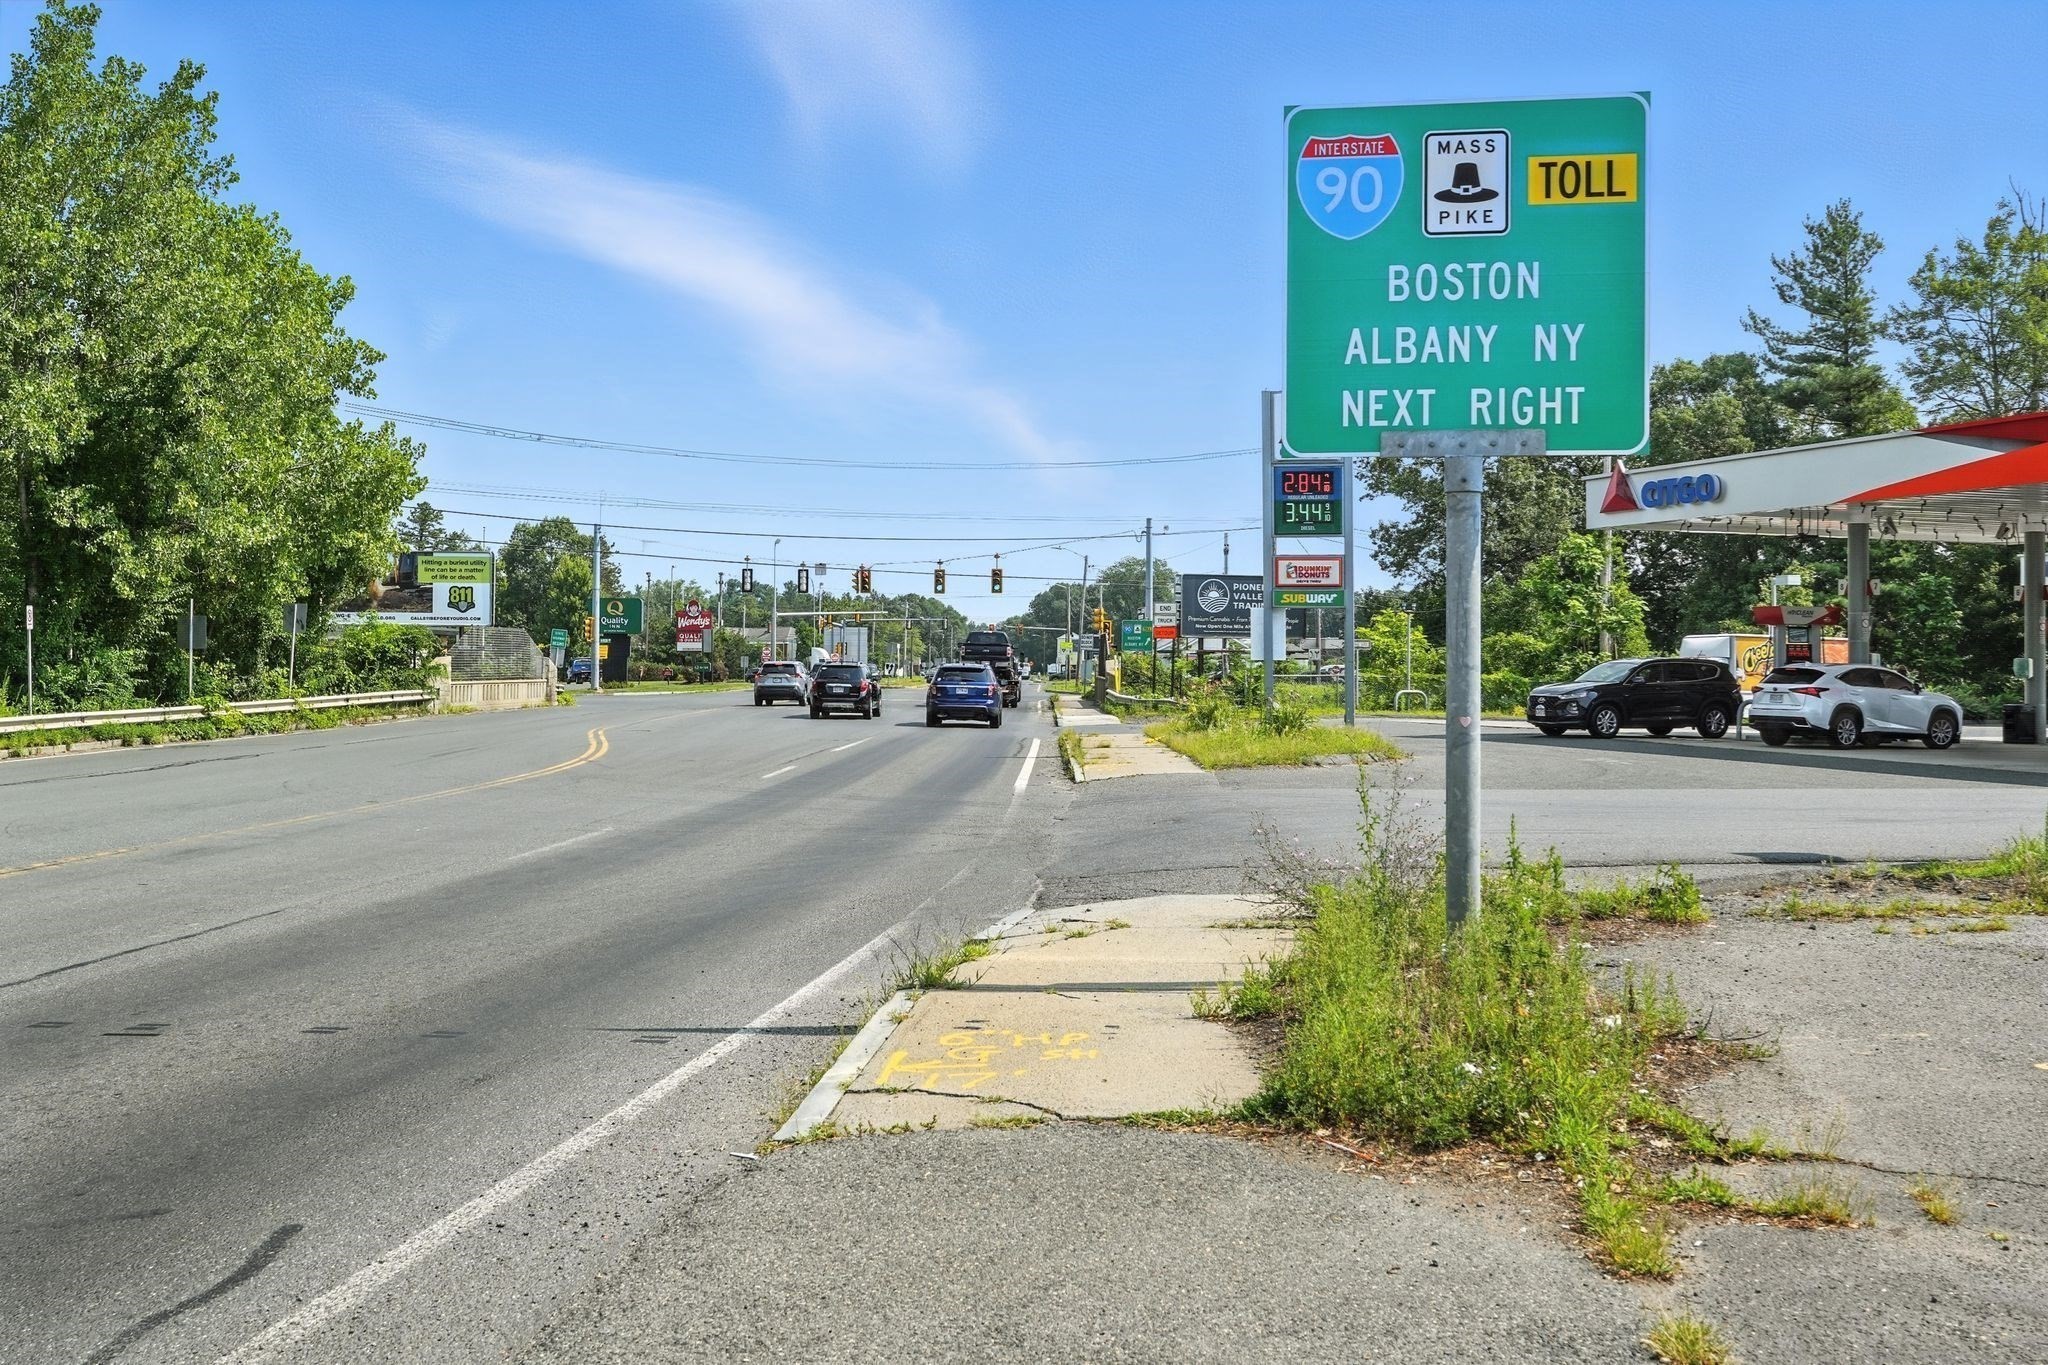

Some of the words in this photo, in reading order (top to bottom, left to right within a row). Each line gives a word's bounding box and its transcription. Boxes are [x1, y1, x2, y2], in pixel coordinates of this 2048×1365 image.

[1314, 141, 1385, 156] INTERSTATE
[1437, 139, 1496, 155] MASS
[1538, 159, 1627, 199] TOLL
[1315, 165, 1383, 213] 90
[1439, 209, 1494, 225] PIKE
[1388, 261, 1540, 302] BOSTON
[1344, 324, 1498, 365] ALBANY
[1534, 323, 1585, 362] NY
[1342, 388, 1436, 427] NEXT
[1470, 386, 1585, 425] RIGHT
[1284, 473, 1321, 493] 2.84
[1641, 473, 1717, 508] CITGO
[1286, 503, 1321, 522] 3.44
[421, 559, 443, 567] Hitting
[469, 559, 487, 567] utility
[1298, 571, 1330, 579] DONUTS
[449, 586, 473, 604] 811
[1233, 583, 1264, 591] PIONE
[1233, 592, 1263, 601] VALLE
[1280, 593, 1338, 604] SUBWAY
[1233, 602, 1264, 610] TRADIN
[600, 616, 629, 626] Quality
[677, 615, 711, 629] Wendy's
